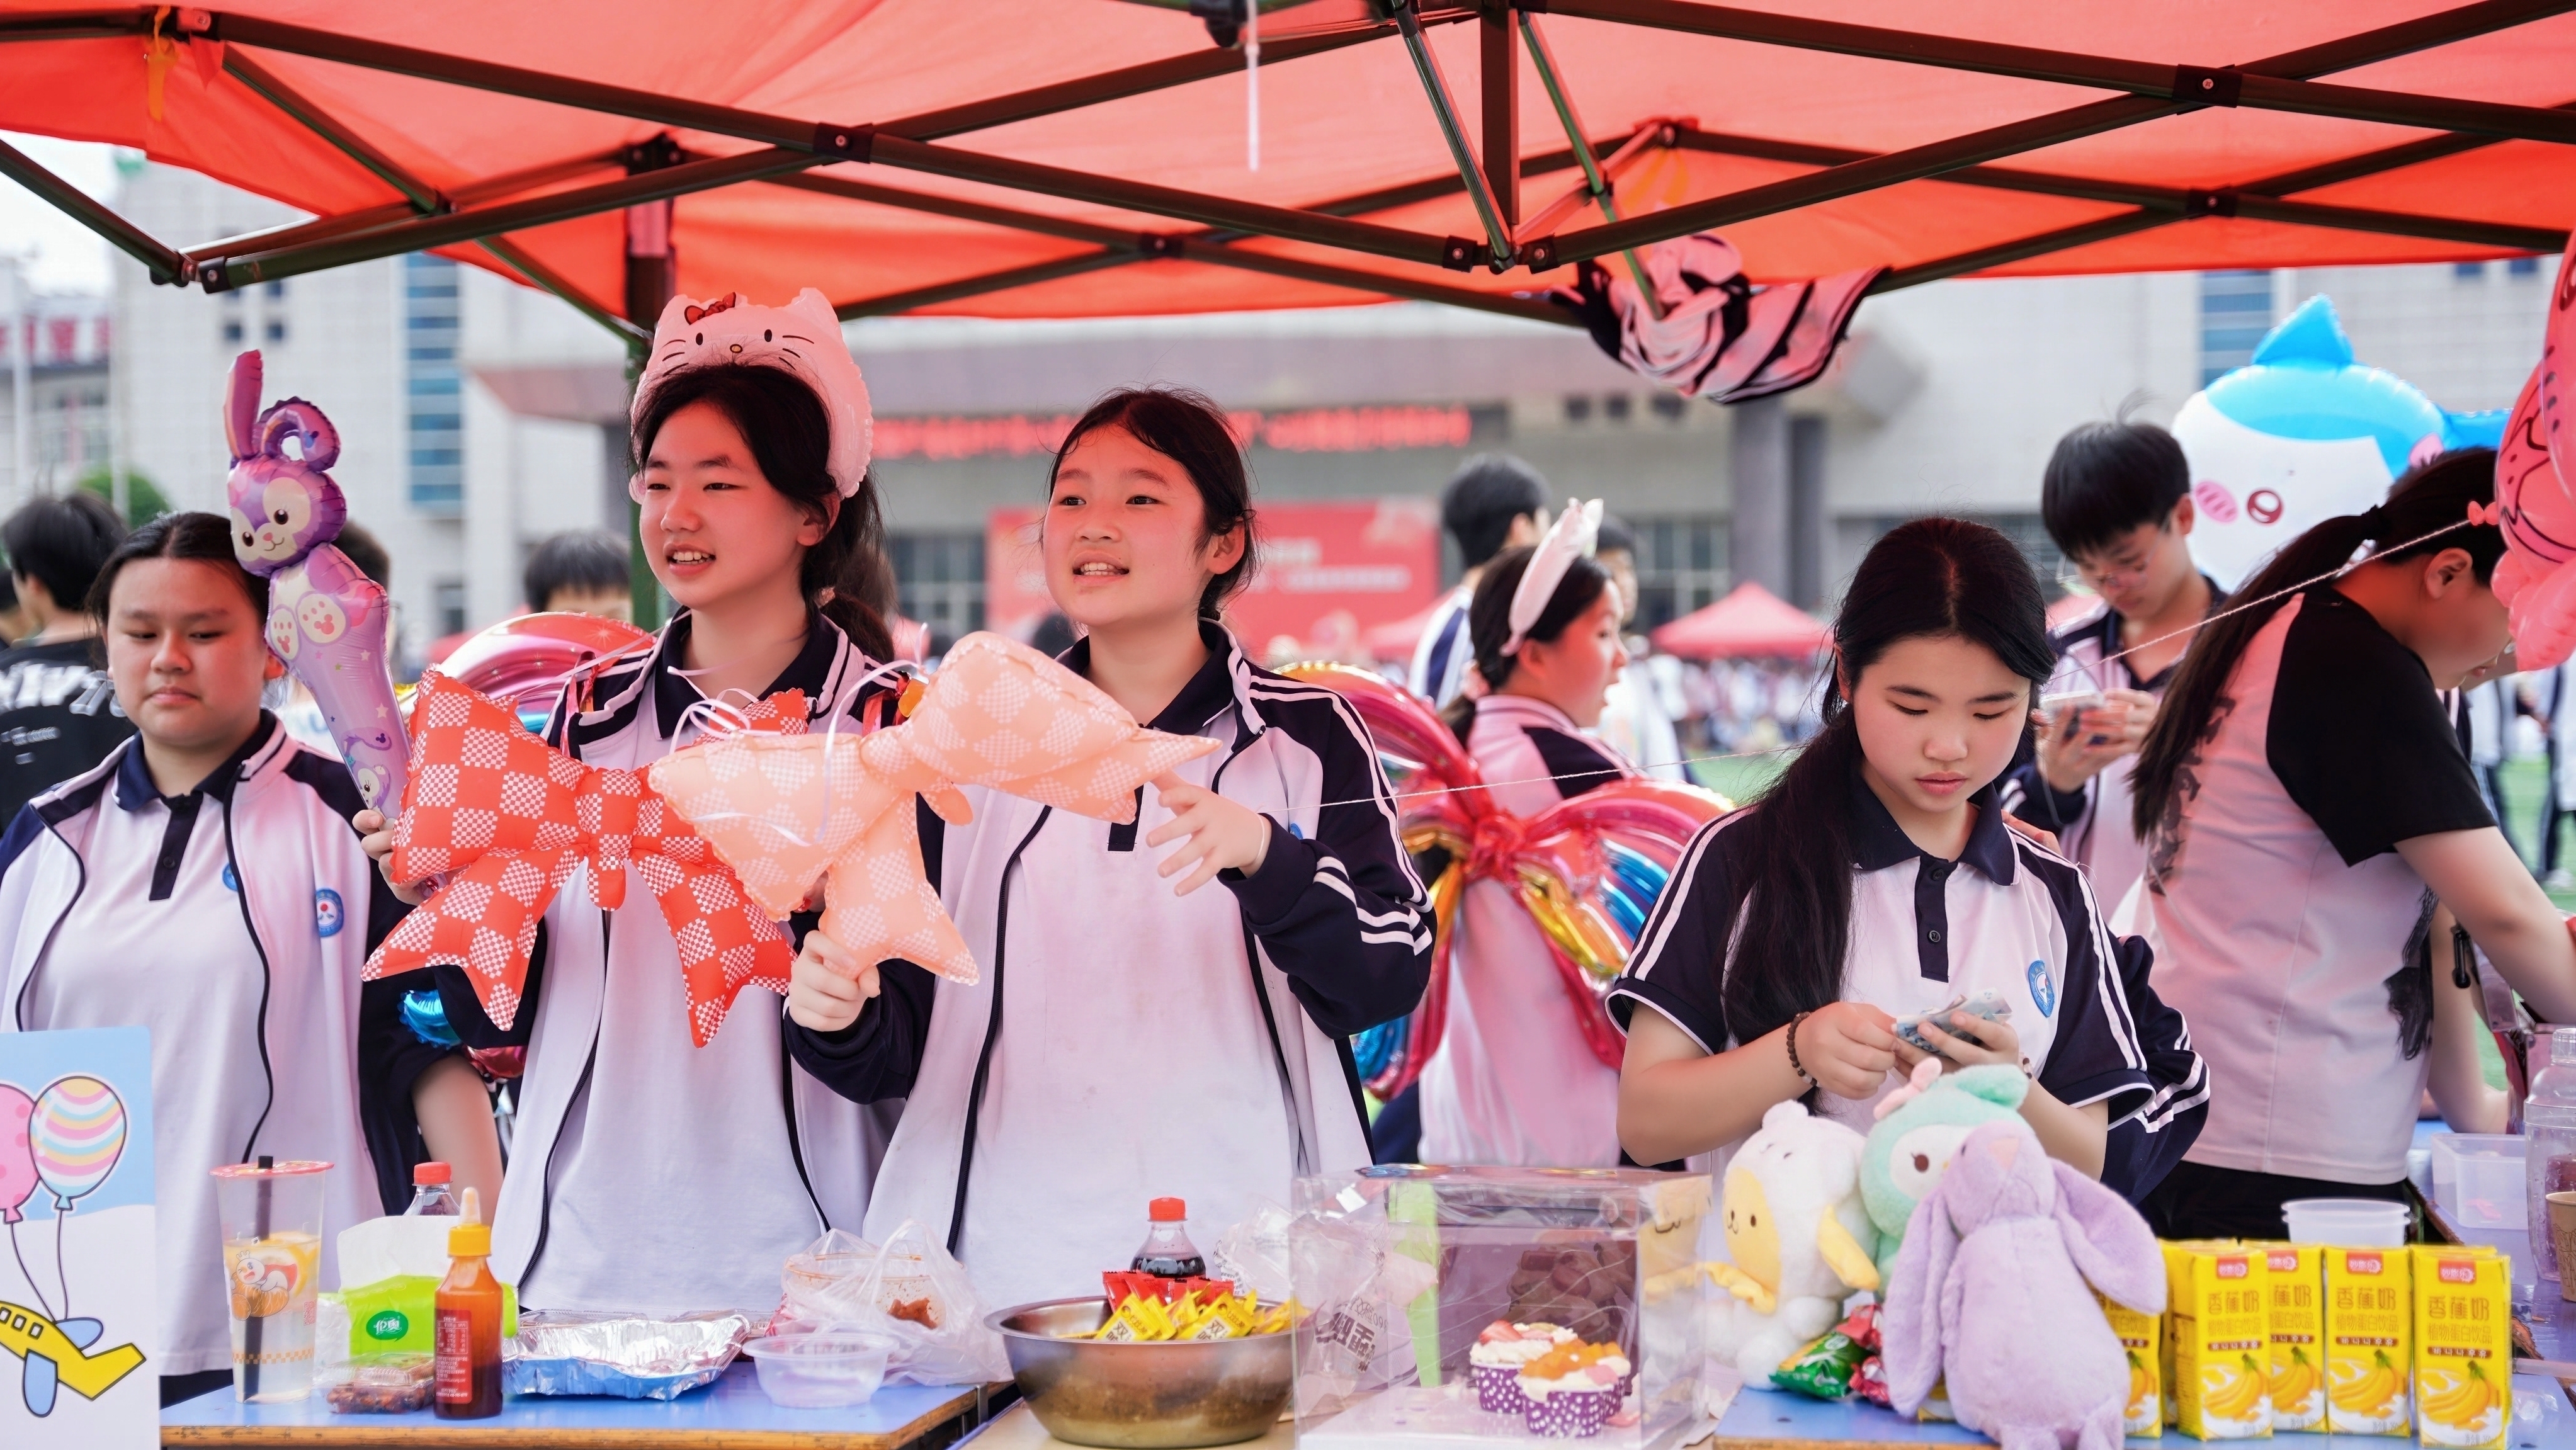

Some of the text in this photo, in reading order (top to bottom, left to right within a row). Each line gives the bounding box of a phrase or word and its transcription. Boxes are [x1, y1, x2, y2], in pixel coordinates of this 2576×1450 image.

[2208, 1290, 2260, 1315] 香蕉奶
[2268, 1284, 2312, 1308] 蕉奶
[2337, 1287, 2396, 1310] 香蕉奶
[2429, 1295, 2490, 1321] 香蕉奶
[2208, 1317, 2262, 1337] 植物蛋白饮品
[2335, 1313, 2399, 1332] 植物蛋白饮品
[2427, 1323, 2493, 1345] 植物蛋白饮品
